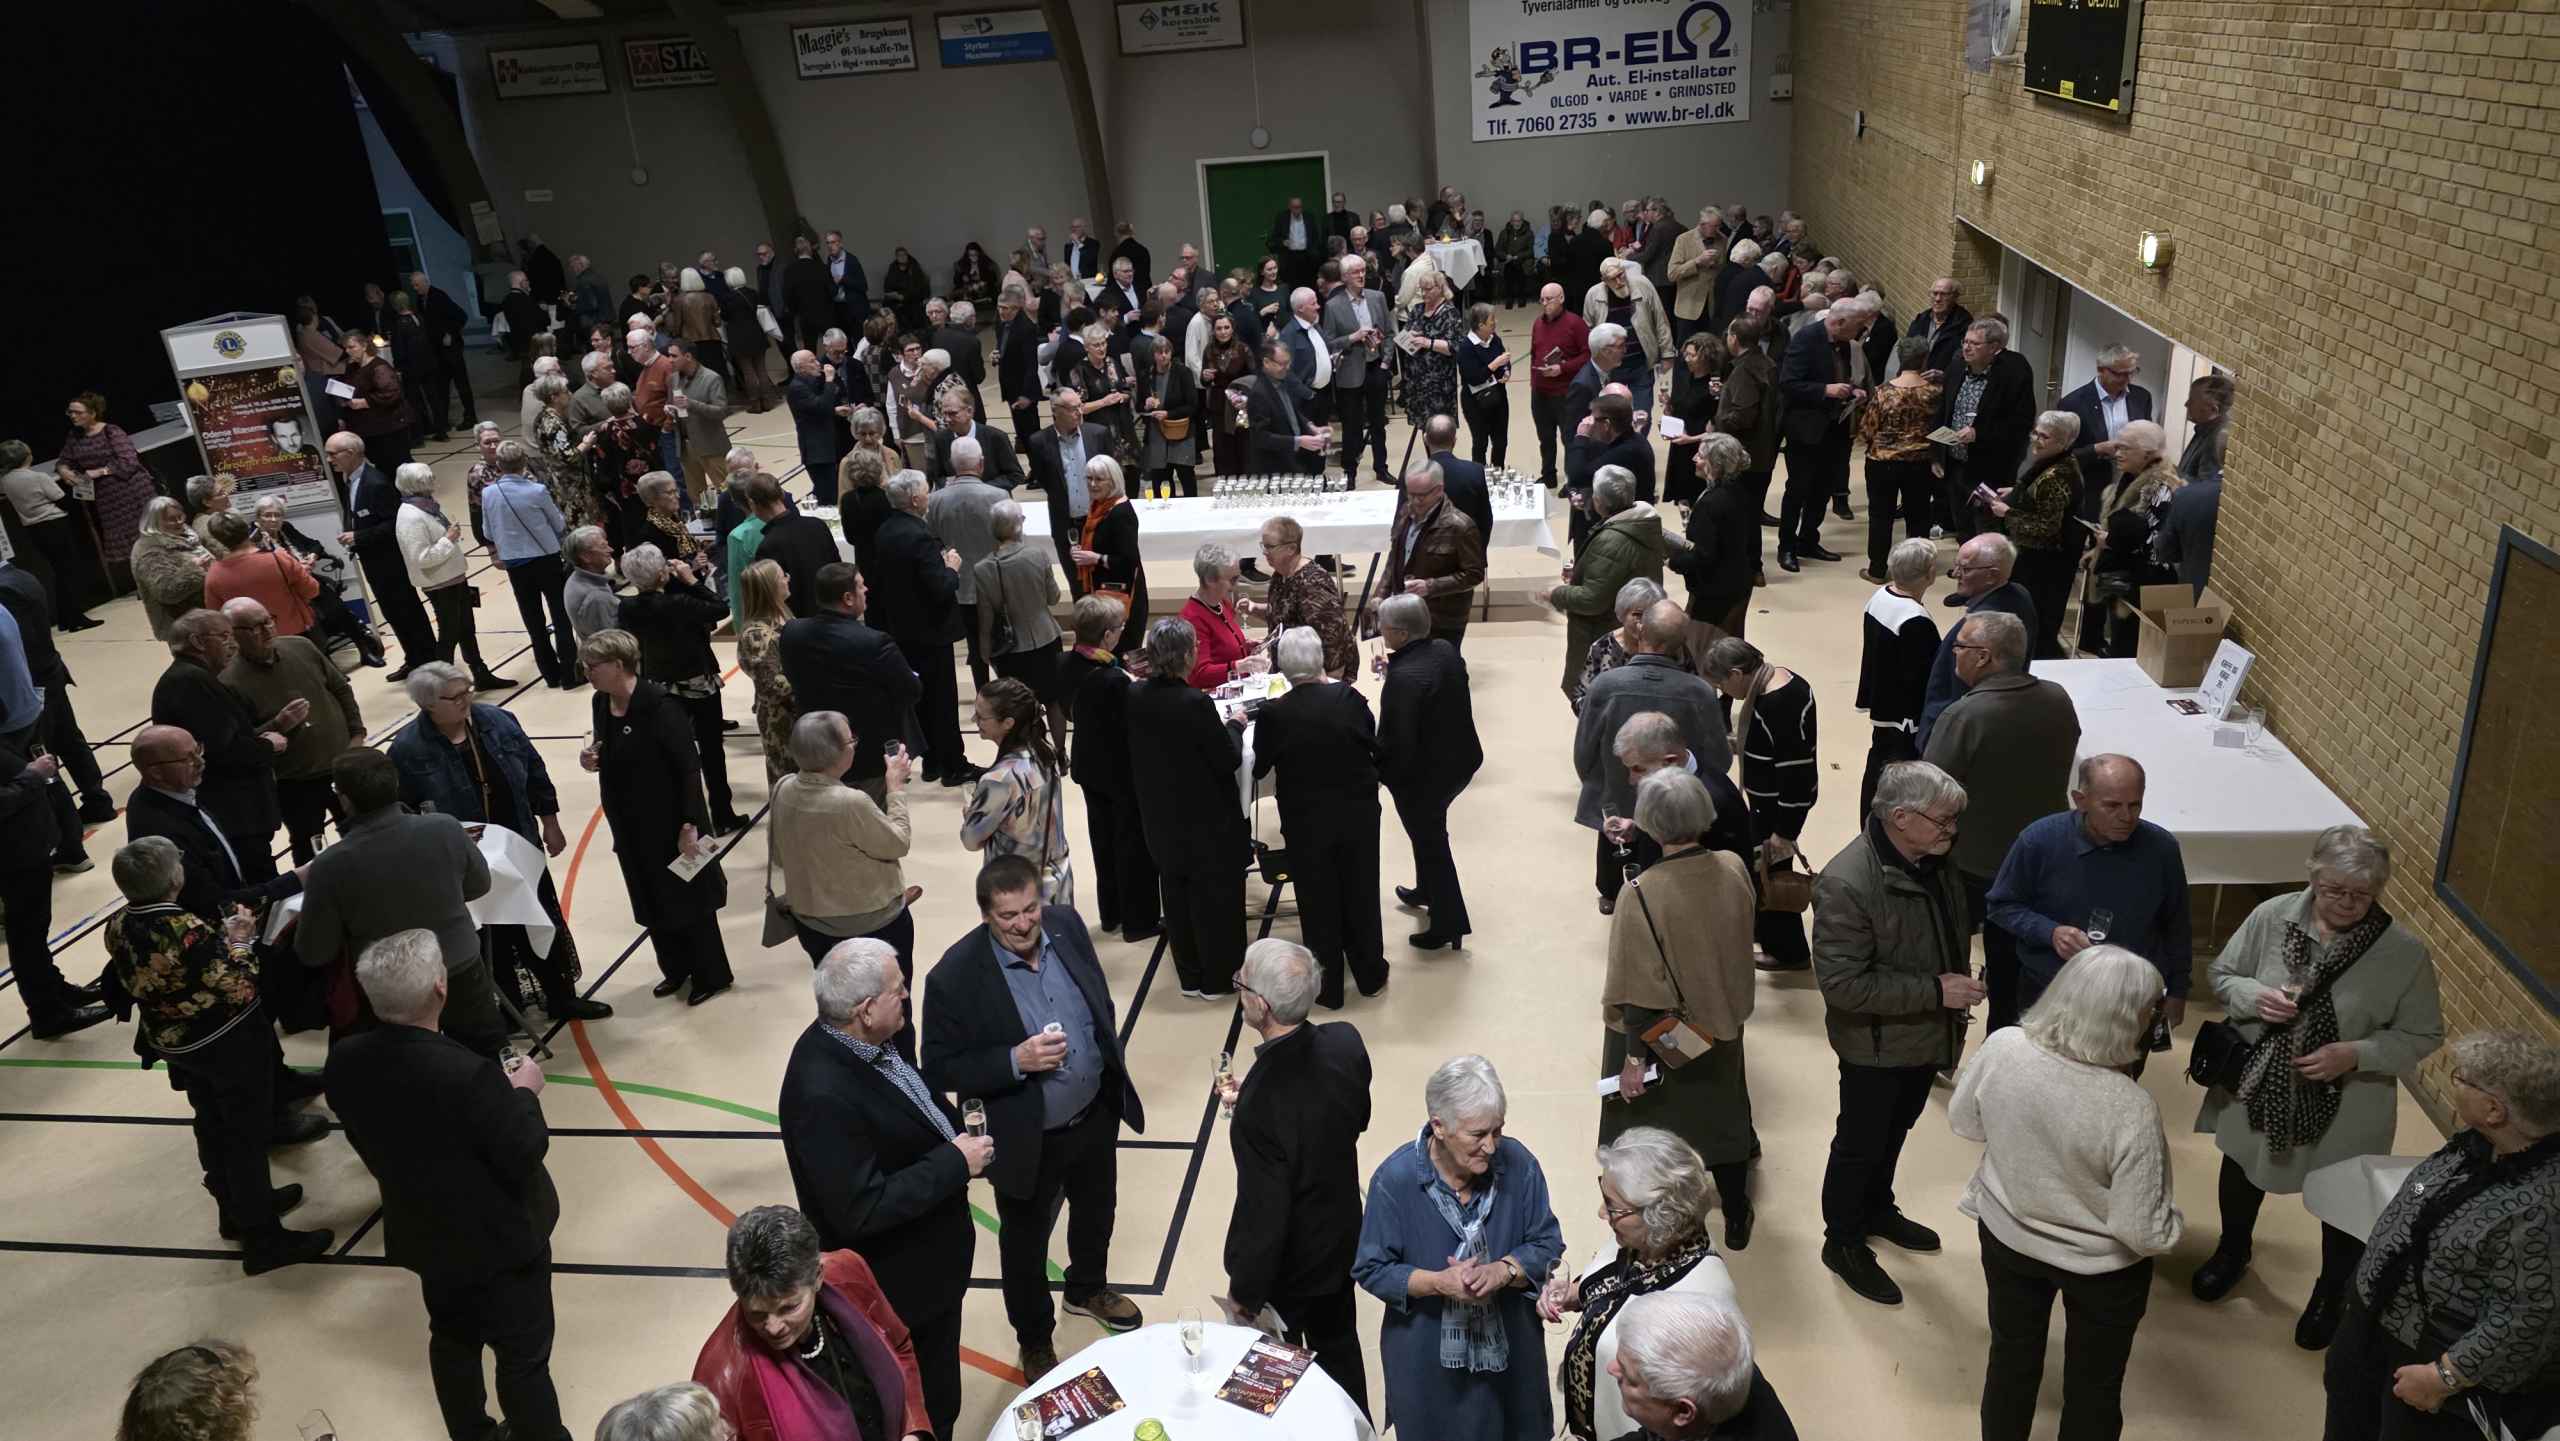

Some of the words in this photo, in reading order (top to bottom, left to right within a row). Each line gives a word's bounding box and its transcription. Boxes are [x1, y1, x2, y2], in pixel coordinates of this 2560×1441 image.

[1161, 2, 1218, 17] M&K
[798, 27, 850, 55] Maggie's
[662, 44, 706, 70] STA
[1586, 73, 1621, 88] Aut.
[1628, 65, 1737, 85] El-installatør
[1550, 94, 1589, 109] ØLGOD
[1608, 89, 1648, 104] VARDE
[1668, 81, 1736, 99] GRINDSTED
[1487, 119, 1511, 136] Tlf.
[1517, 115, 1555, 134] 7060
[1559, 112, 1597, 132] 2735
[1625, 102, 1736, 125] www.br-el.dk
